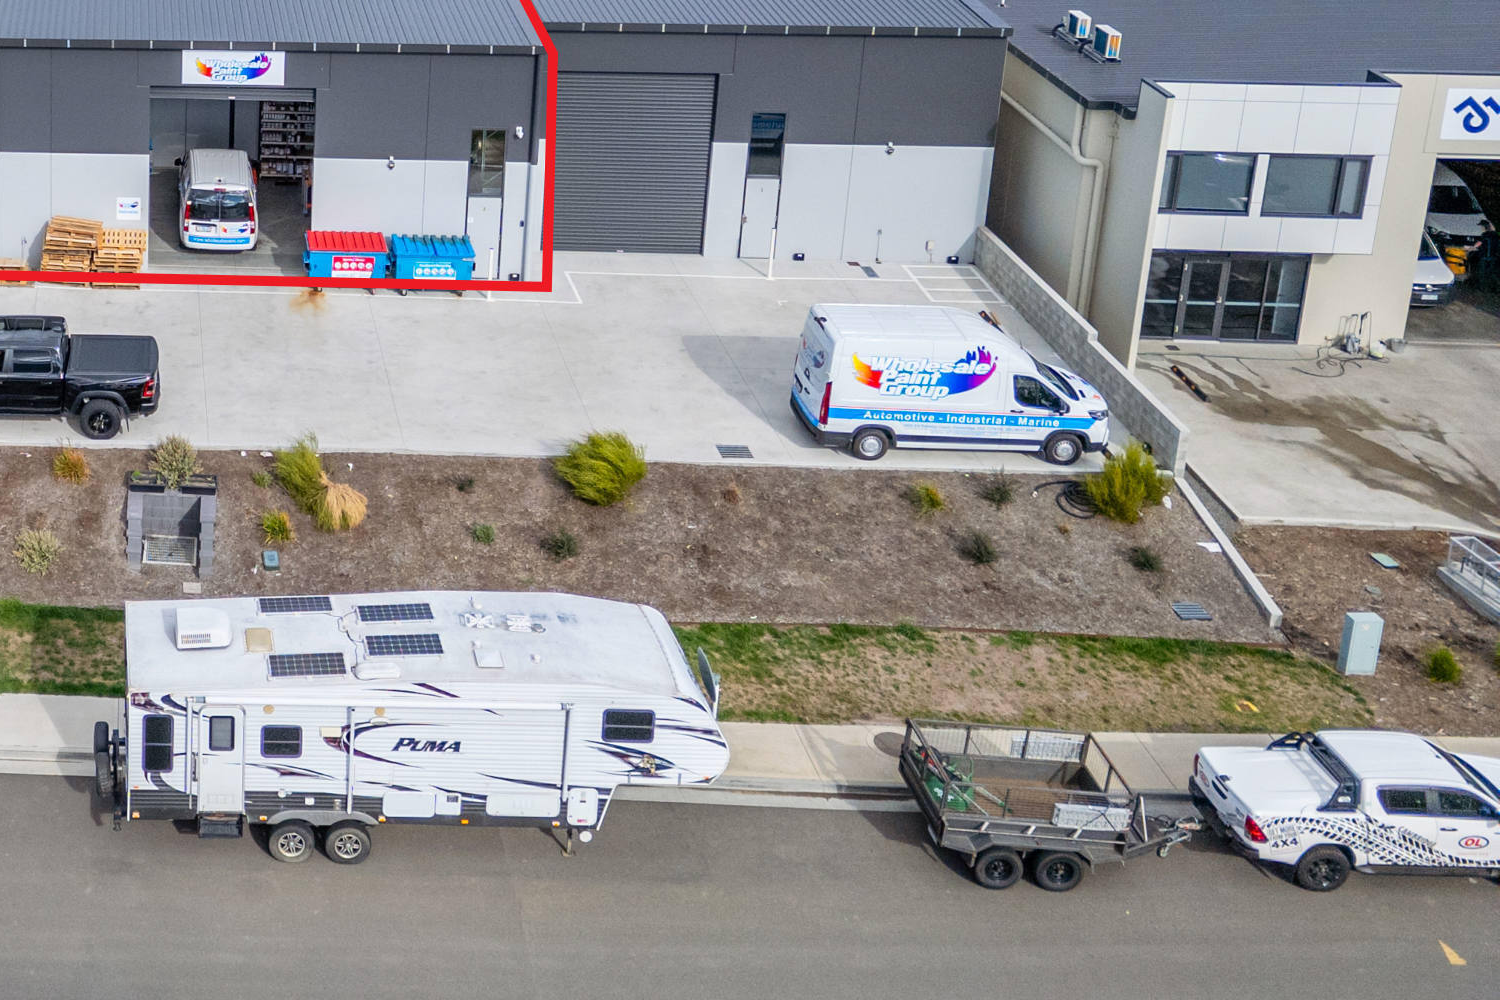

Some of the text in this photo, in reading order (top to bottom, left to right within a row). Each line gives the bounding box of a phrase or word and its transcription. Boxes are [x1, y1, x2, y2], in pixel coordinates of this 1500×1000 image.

[205, 59, 268, 69] Wholesale
[211, 67, 244, 76] Paint
[211, 74, 248, 83] Group
[870, 355, 992, 375] Wholesale
[878, 370, 942, 386] Paint
[878, 383, 950, 401] Group
[863, 410, 935, 422] Automotive
[946, 413, 1006, 425] Industrial
[1017, 417, 1060, 428] Marine
[390, 737, 462, 753] PUMA
[1271, 837, 1299, 849] 4X4
[1464, 838, 1483, 847] OL
